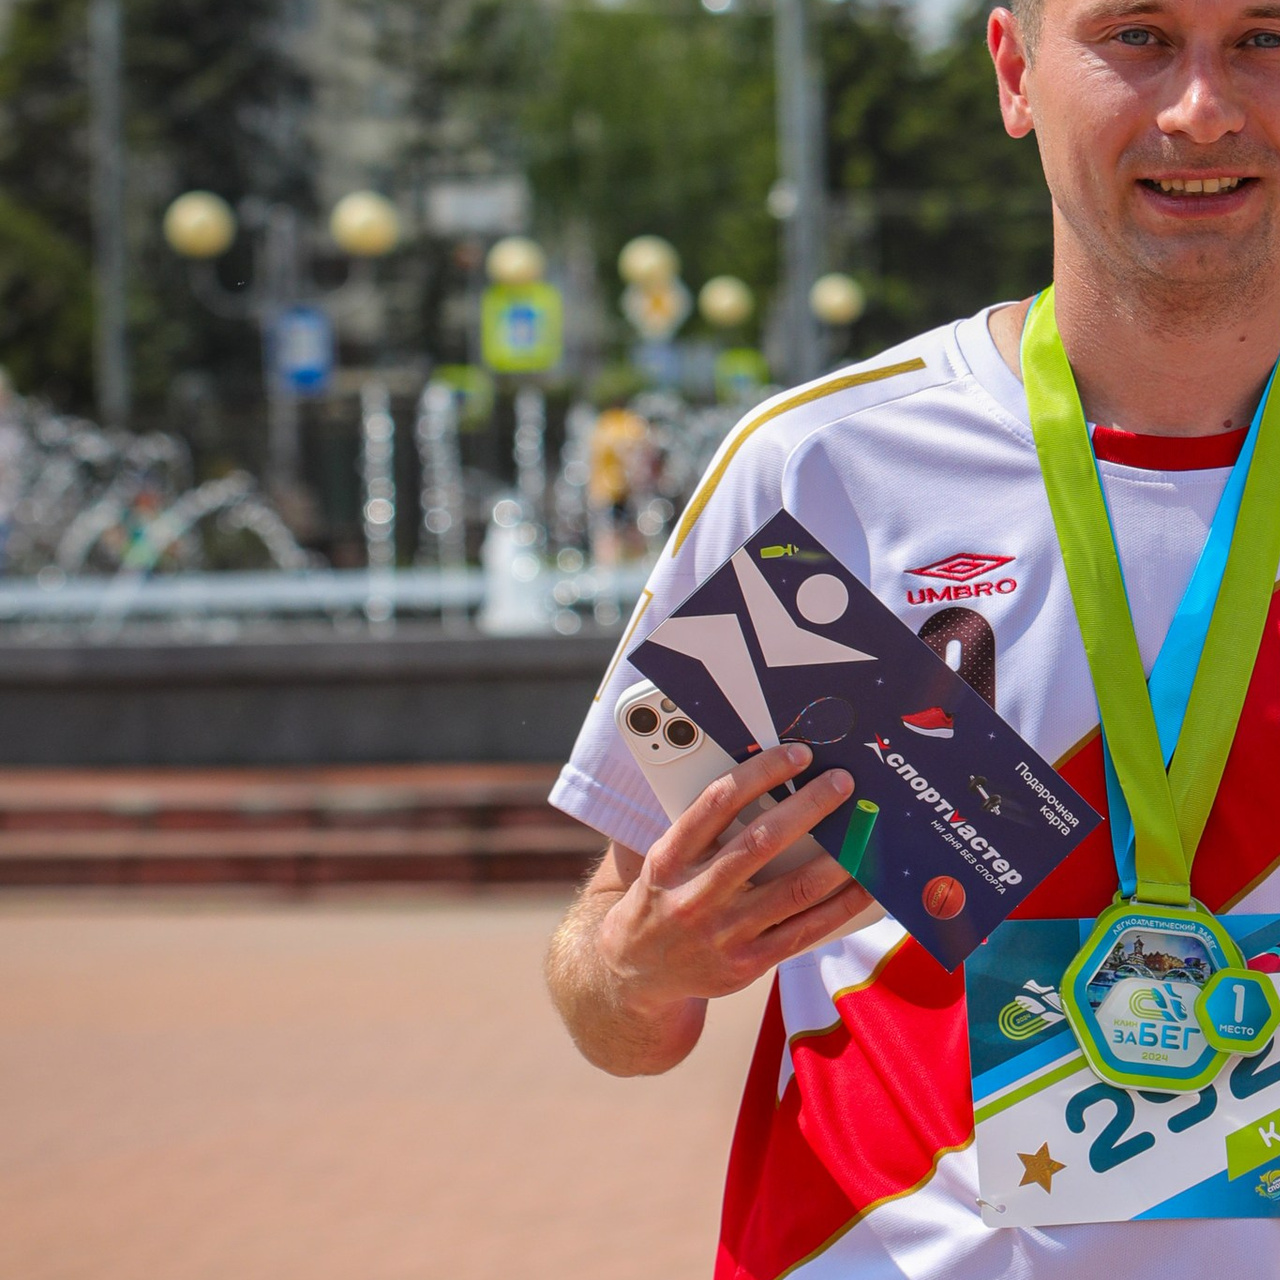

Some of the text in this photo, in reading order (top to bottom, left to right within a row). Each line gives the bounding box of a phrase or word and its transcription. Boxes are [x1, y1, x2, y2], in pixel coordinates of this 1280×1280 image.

[906, 578, 1017, 605] UMBRO
[1014, 761, 1080, 829] Подарочная
[1039, 805, 1071, 837] карта
[931, 819, 1007, 895] НИ ДНЯ БЕЗ СПОРТА
[1112, 918, 1218, 950] ЛЕГКОАТЛЕТИЧЕСКИЙ ЗАБЕГ
[1232, 984, 1246, 1024] 1
[1113, 1019, 1138, 1028] КЛИН
[1219, 1024, 1255, 1037] МЕСТО
[1141, 1052, 1169, 1062] 2024
